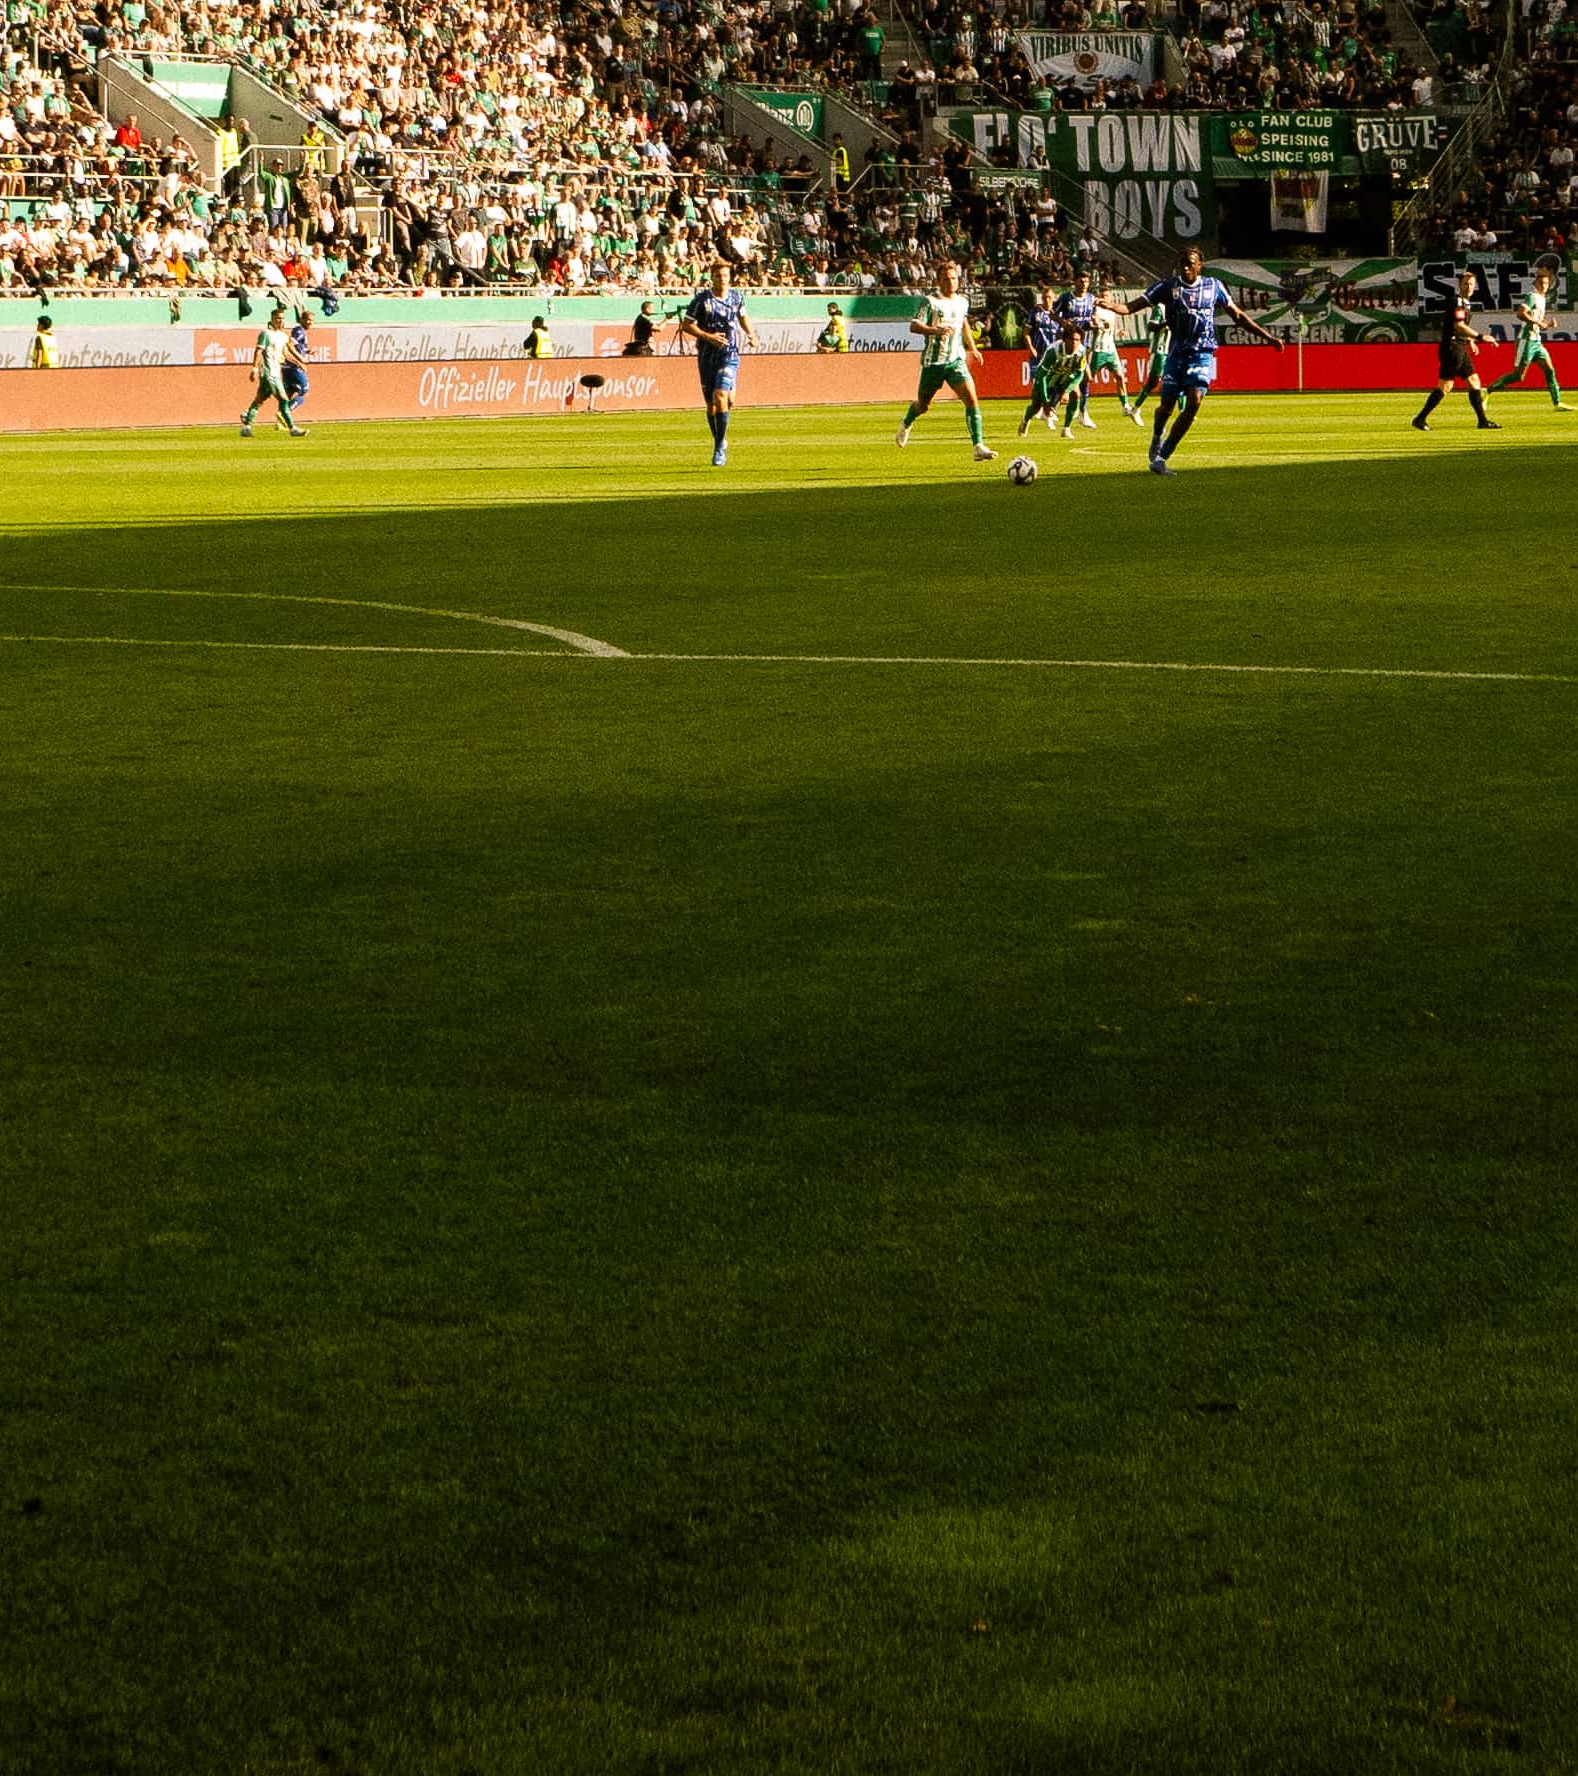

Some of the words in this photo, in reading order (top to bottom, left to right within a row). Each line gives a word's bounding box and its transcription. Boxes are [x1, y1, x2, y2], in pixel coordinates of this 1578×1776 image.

[1030, 36, 1090, 64] VIRIBUS
[1093, 36, 1143, 64] UNITIS
[1261, 115, 1290, 128] FAN
[1295, 115, 1333, 128] CLUB
[1067, 113, 1202, 174] TOWN
[1260, 133, 1330, 148] SPEISING
[1261, 151, 1304, 164] SINCE
[1308, 151, 1334, 163] 1981
[1083, 179, 1203, 239] BOYS
[418, 365, 517, 409] Offizieller
